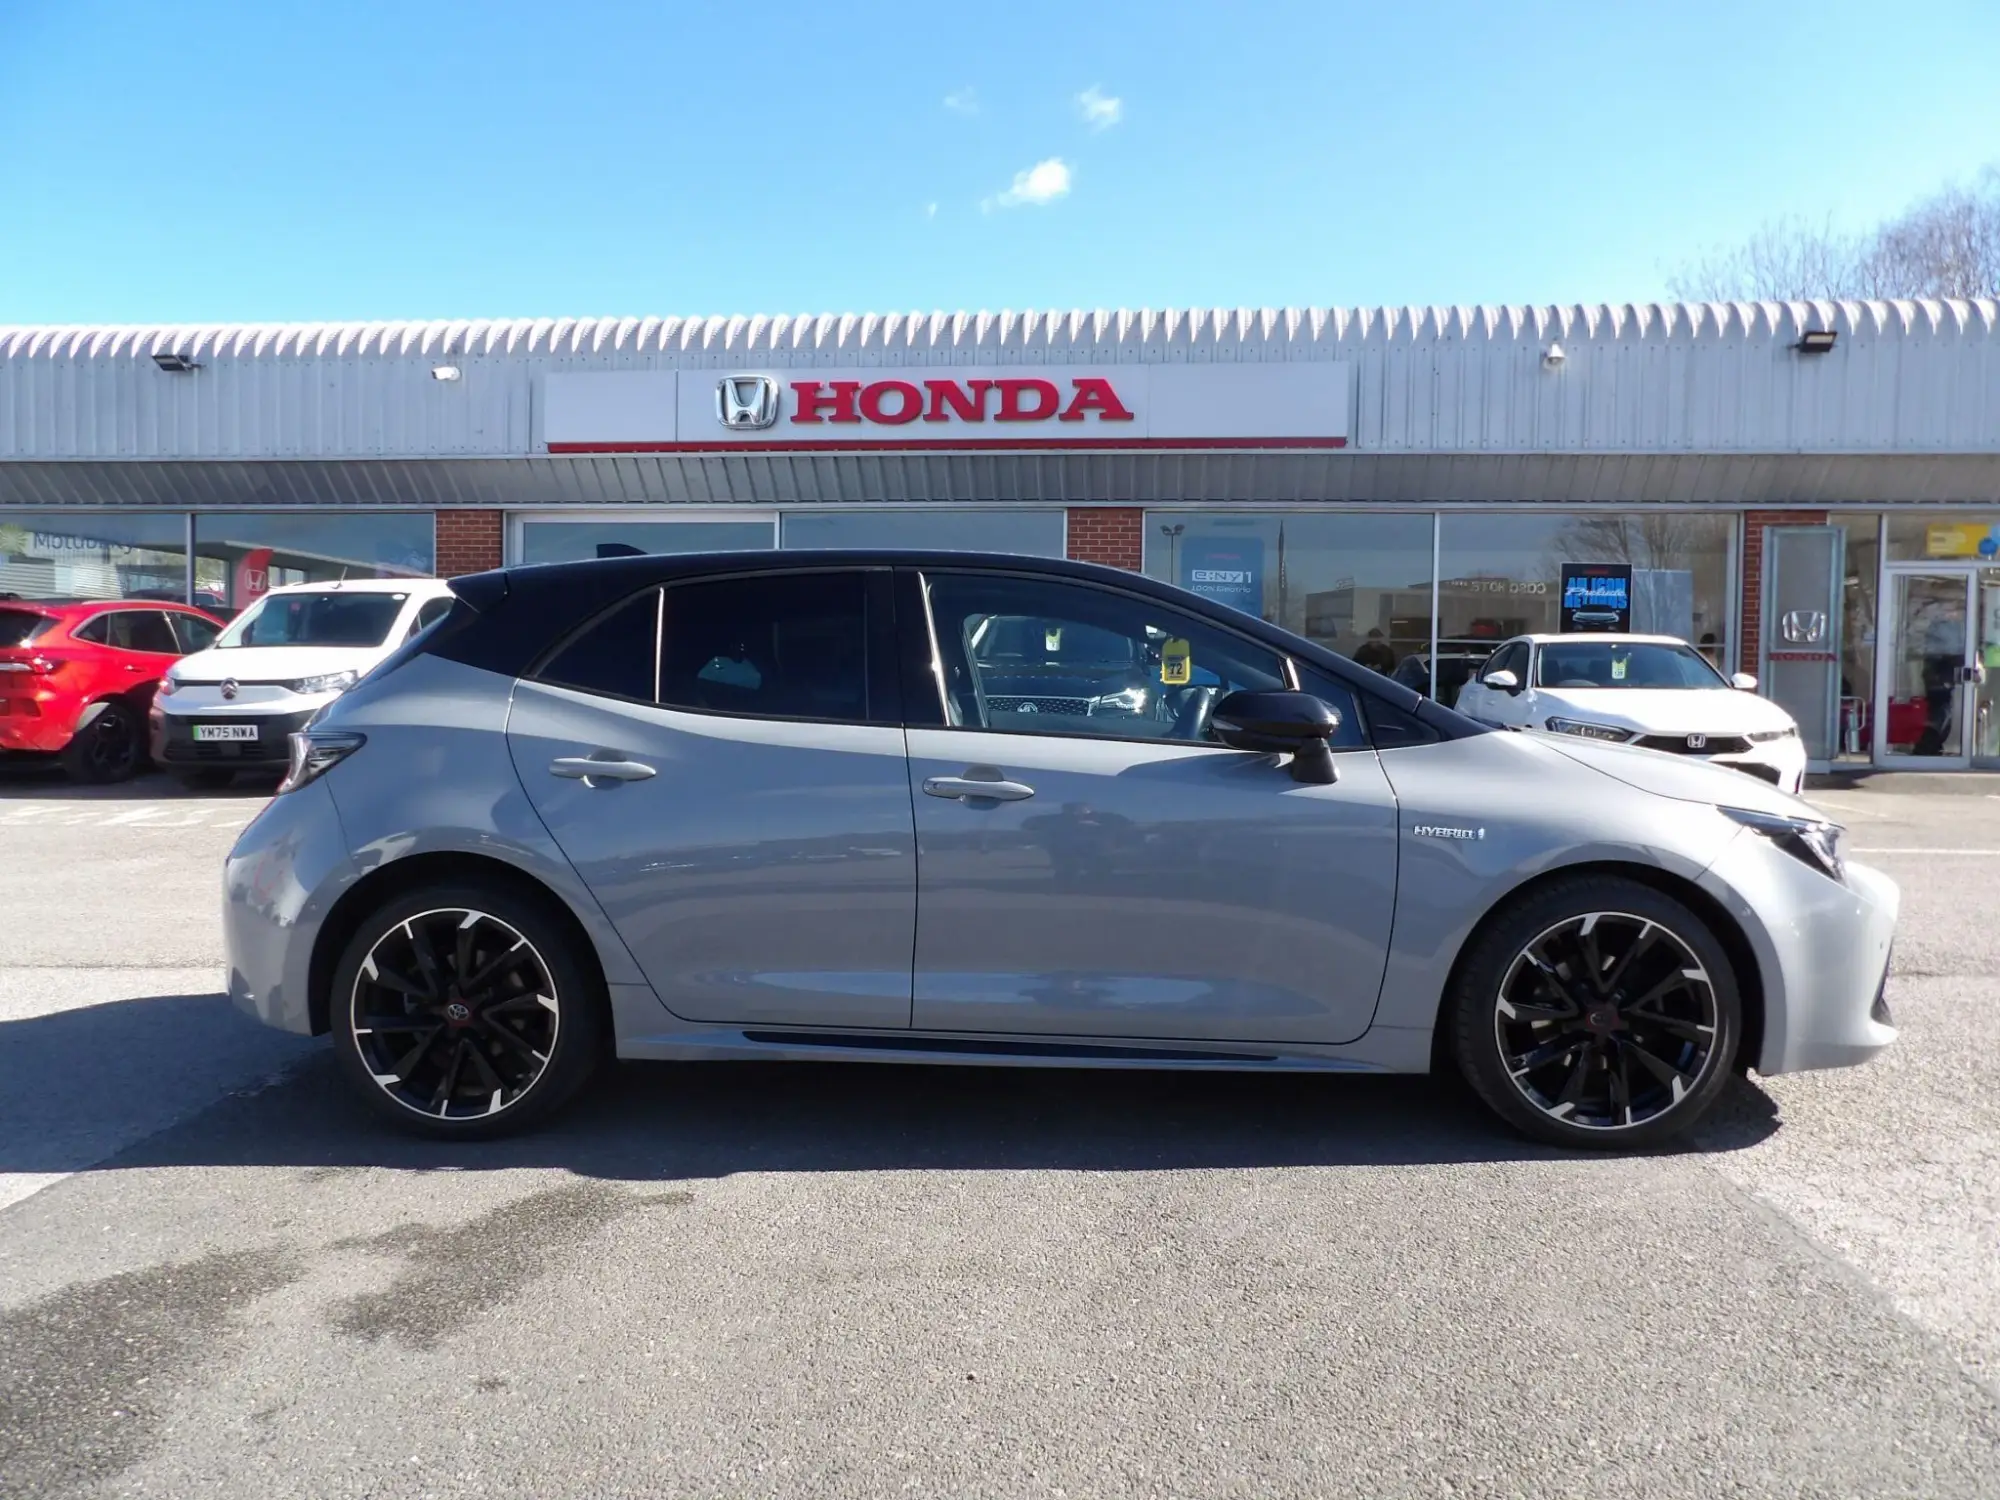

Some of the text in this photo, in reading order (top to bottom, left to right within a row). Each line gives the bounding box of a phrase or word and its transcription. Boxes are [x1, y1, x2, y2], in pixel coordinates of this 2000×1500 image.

[789, 378, 1135, 426] HONDA
[33, 530, 133, 555] Motaby
[200, 727, 256, 738] YM75 NWA
[1414, 825, 1477, 839] HYBRID
